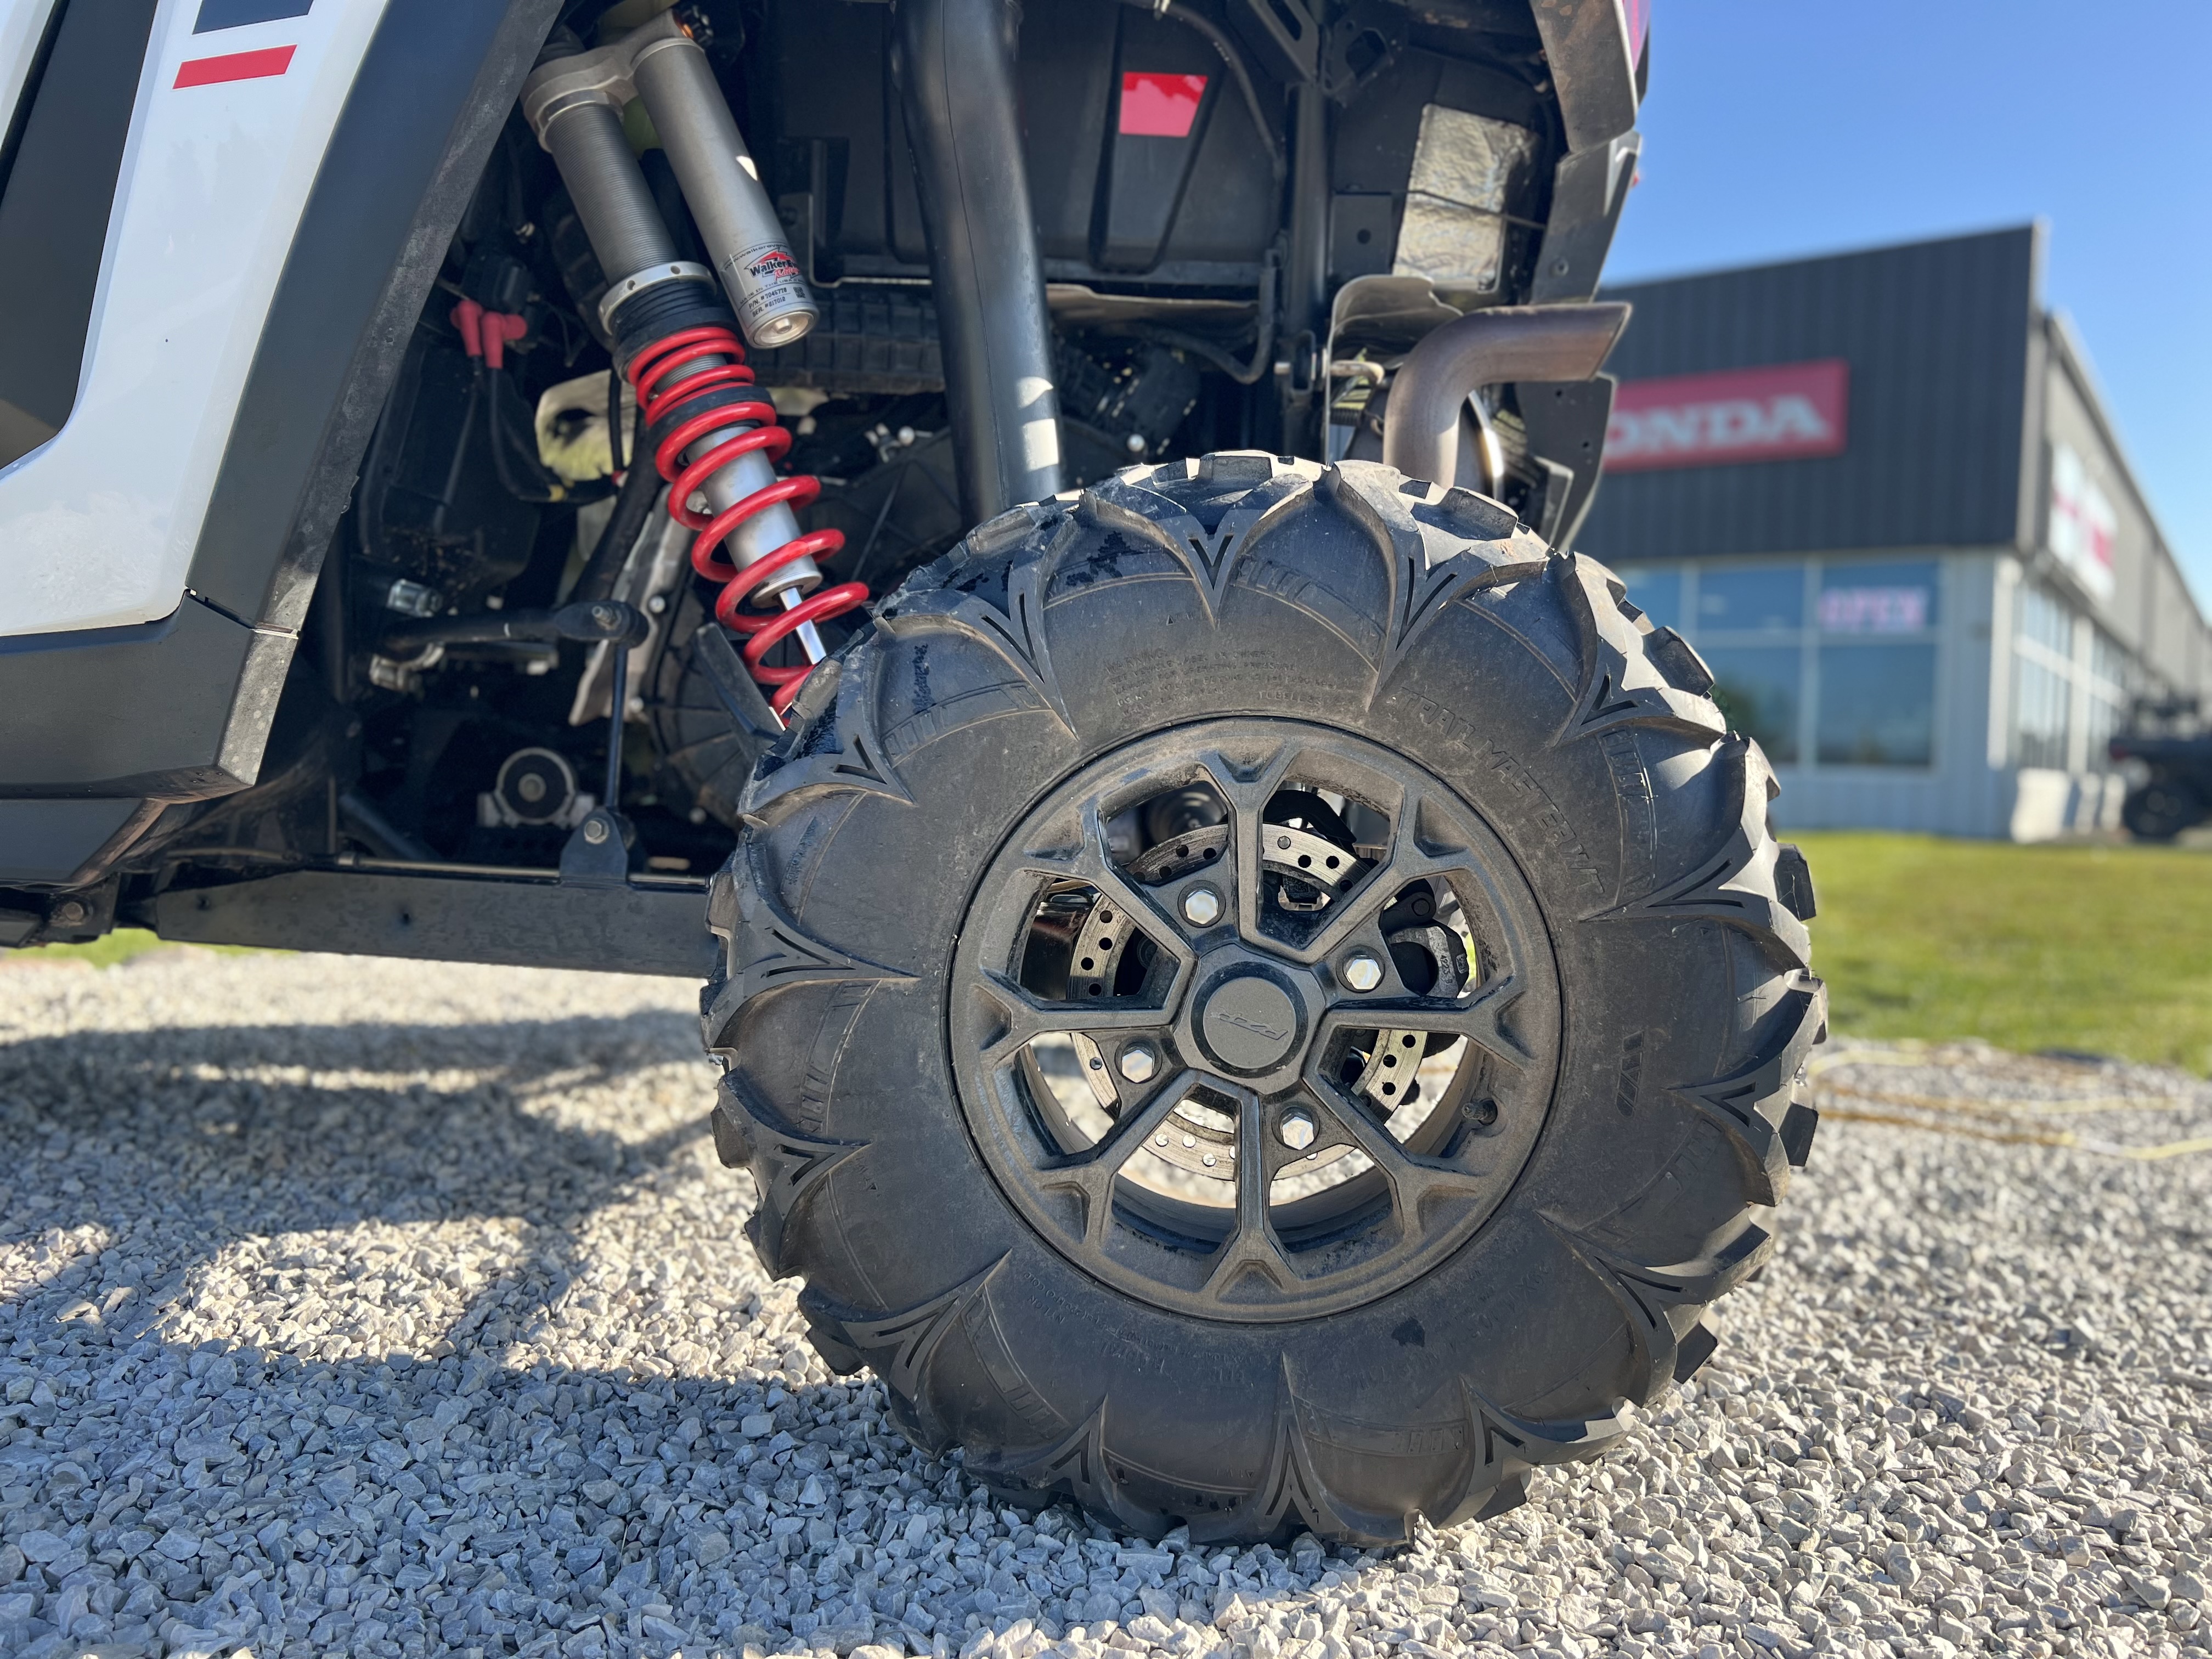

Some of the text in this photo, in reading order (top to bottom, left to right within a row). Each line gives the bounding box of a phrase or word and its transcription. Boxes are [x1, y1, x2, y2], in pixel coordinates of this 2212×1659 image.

[750, 261, 786, 276] Walker
[740, 291, 754, 304] MADE
[752, 307, 764, 317] SER.
[1604, 394, 1832, 459] ONDA
[1257, 690, 1323, 705] TUBELESS
[1394, 686, 1476, 752] TRAIL
[1474, 737, 1577, 848] MASTER
[1023, 1271, 1045, 1291] COLD
[1027, 1293, 1065, 1325] NYLON
